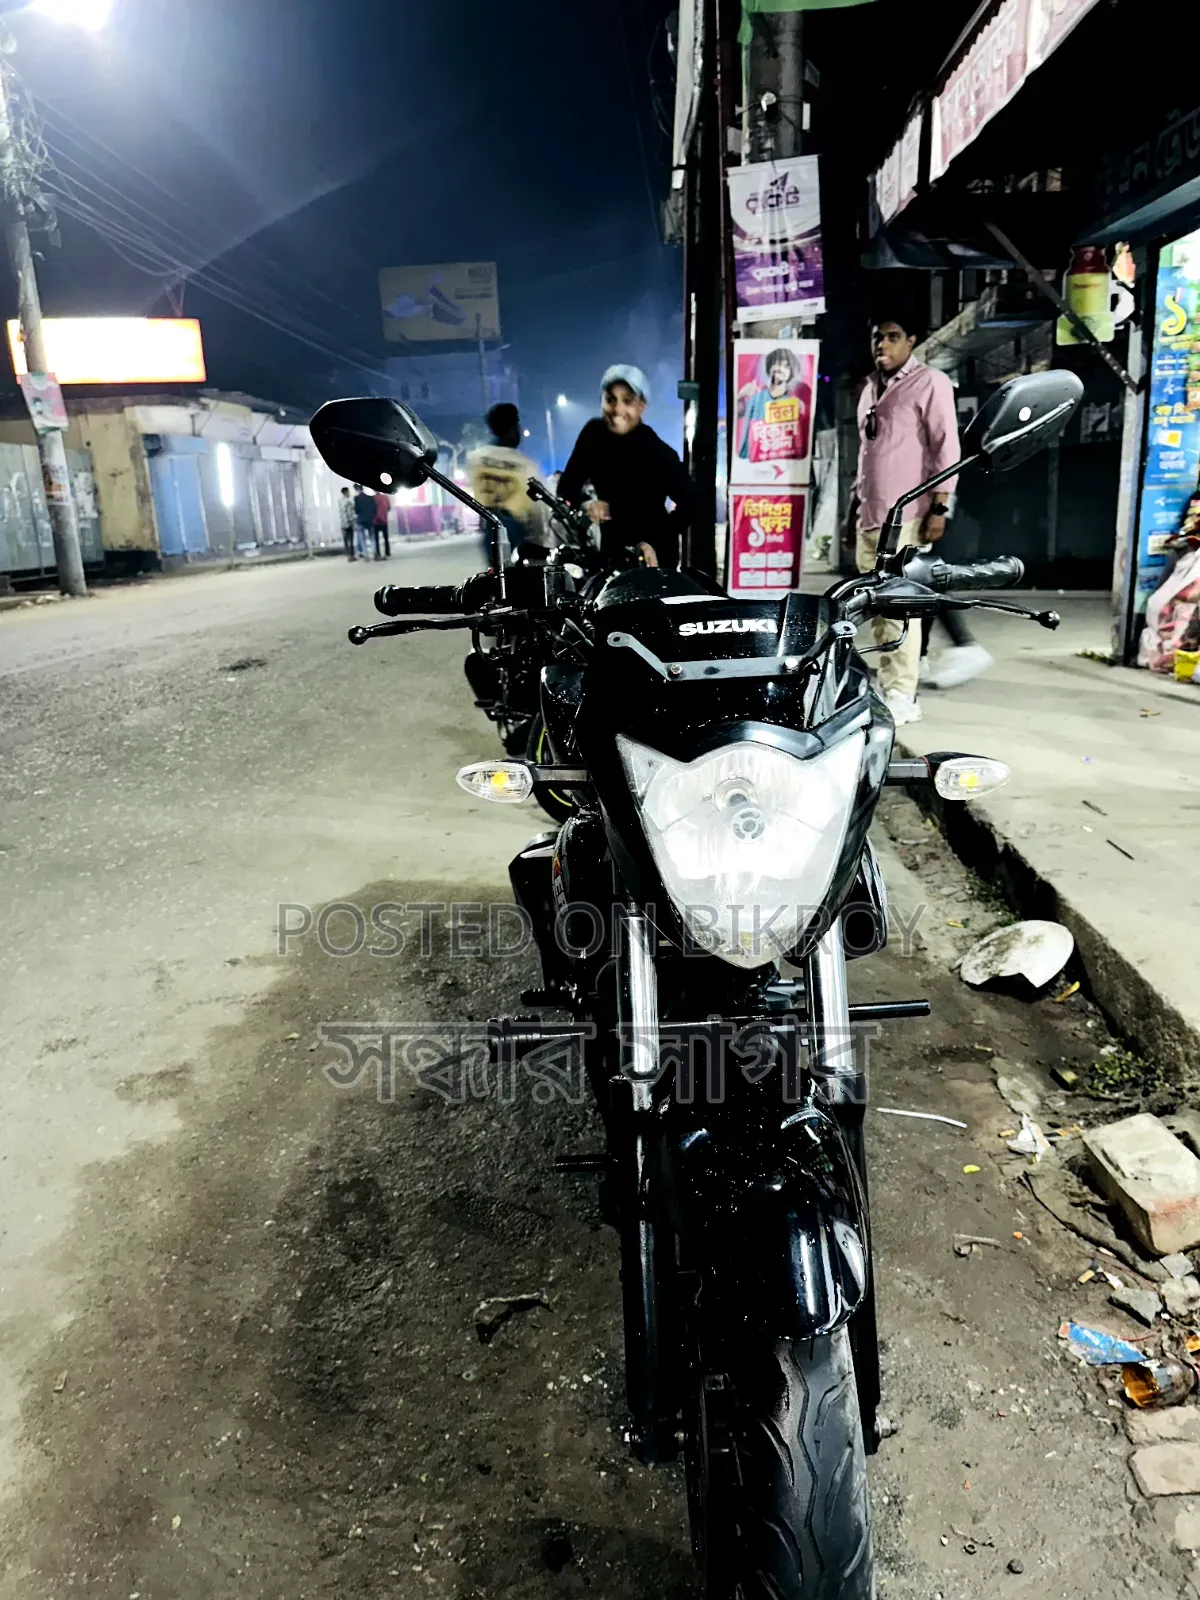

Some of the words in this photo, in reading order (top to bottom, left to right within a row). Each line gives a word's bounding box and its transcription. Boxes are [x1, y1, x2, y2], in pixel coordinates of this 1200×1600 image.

[769, 402, 797, 420] বিল
[744, 499, 792, 517] ডিপিএস
[679, 618, 778, 637] SUZUKI
